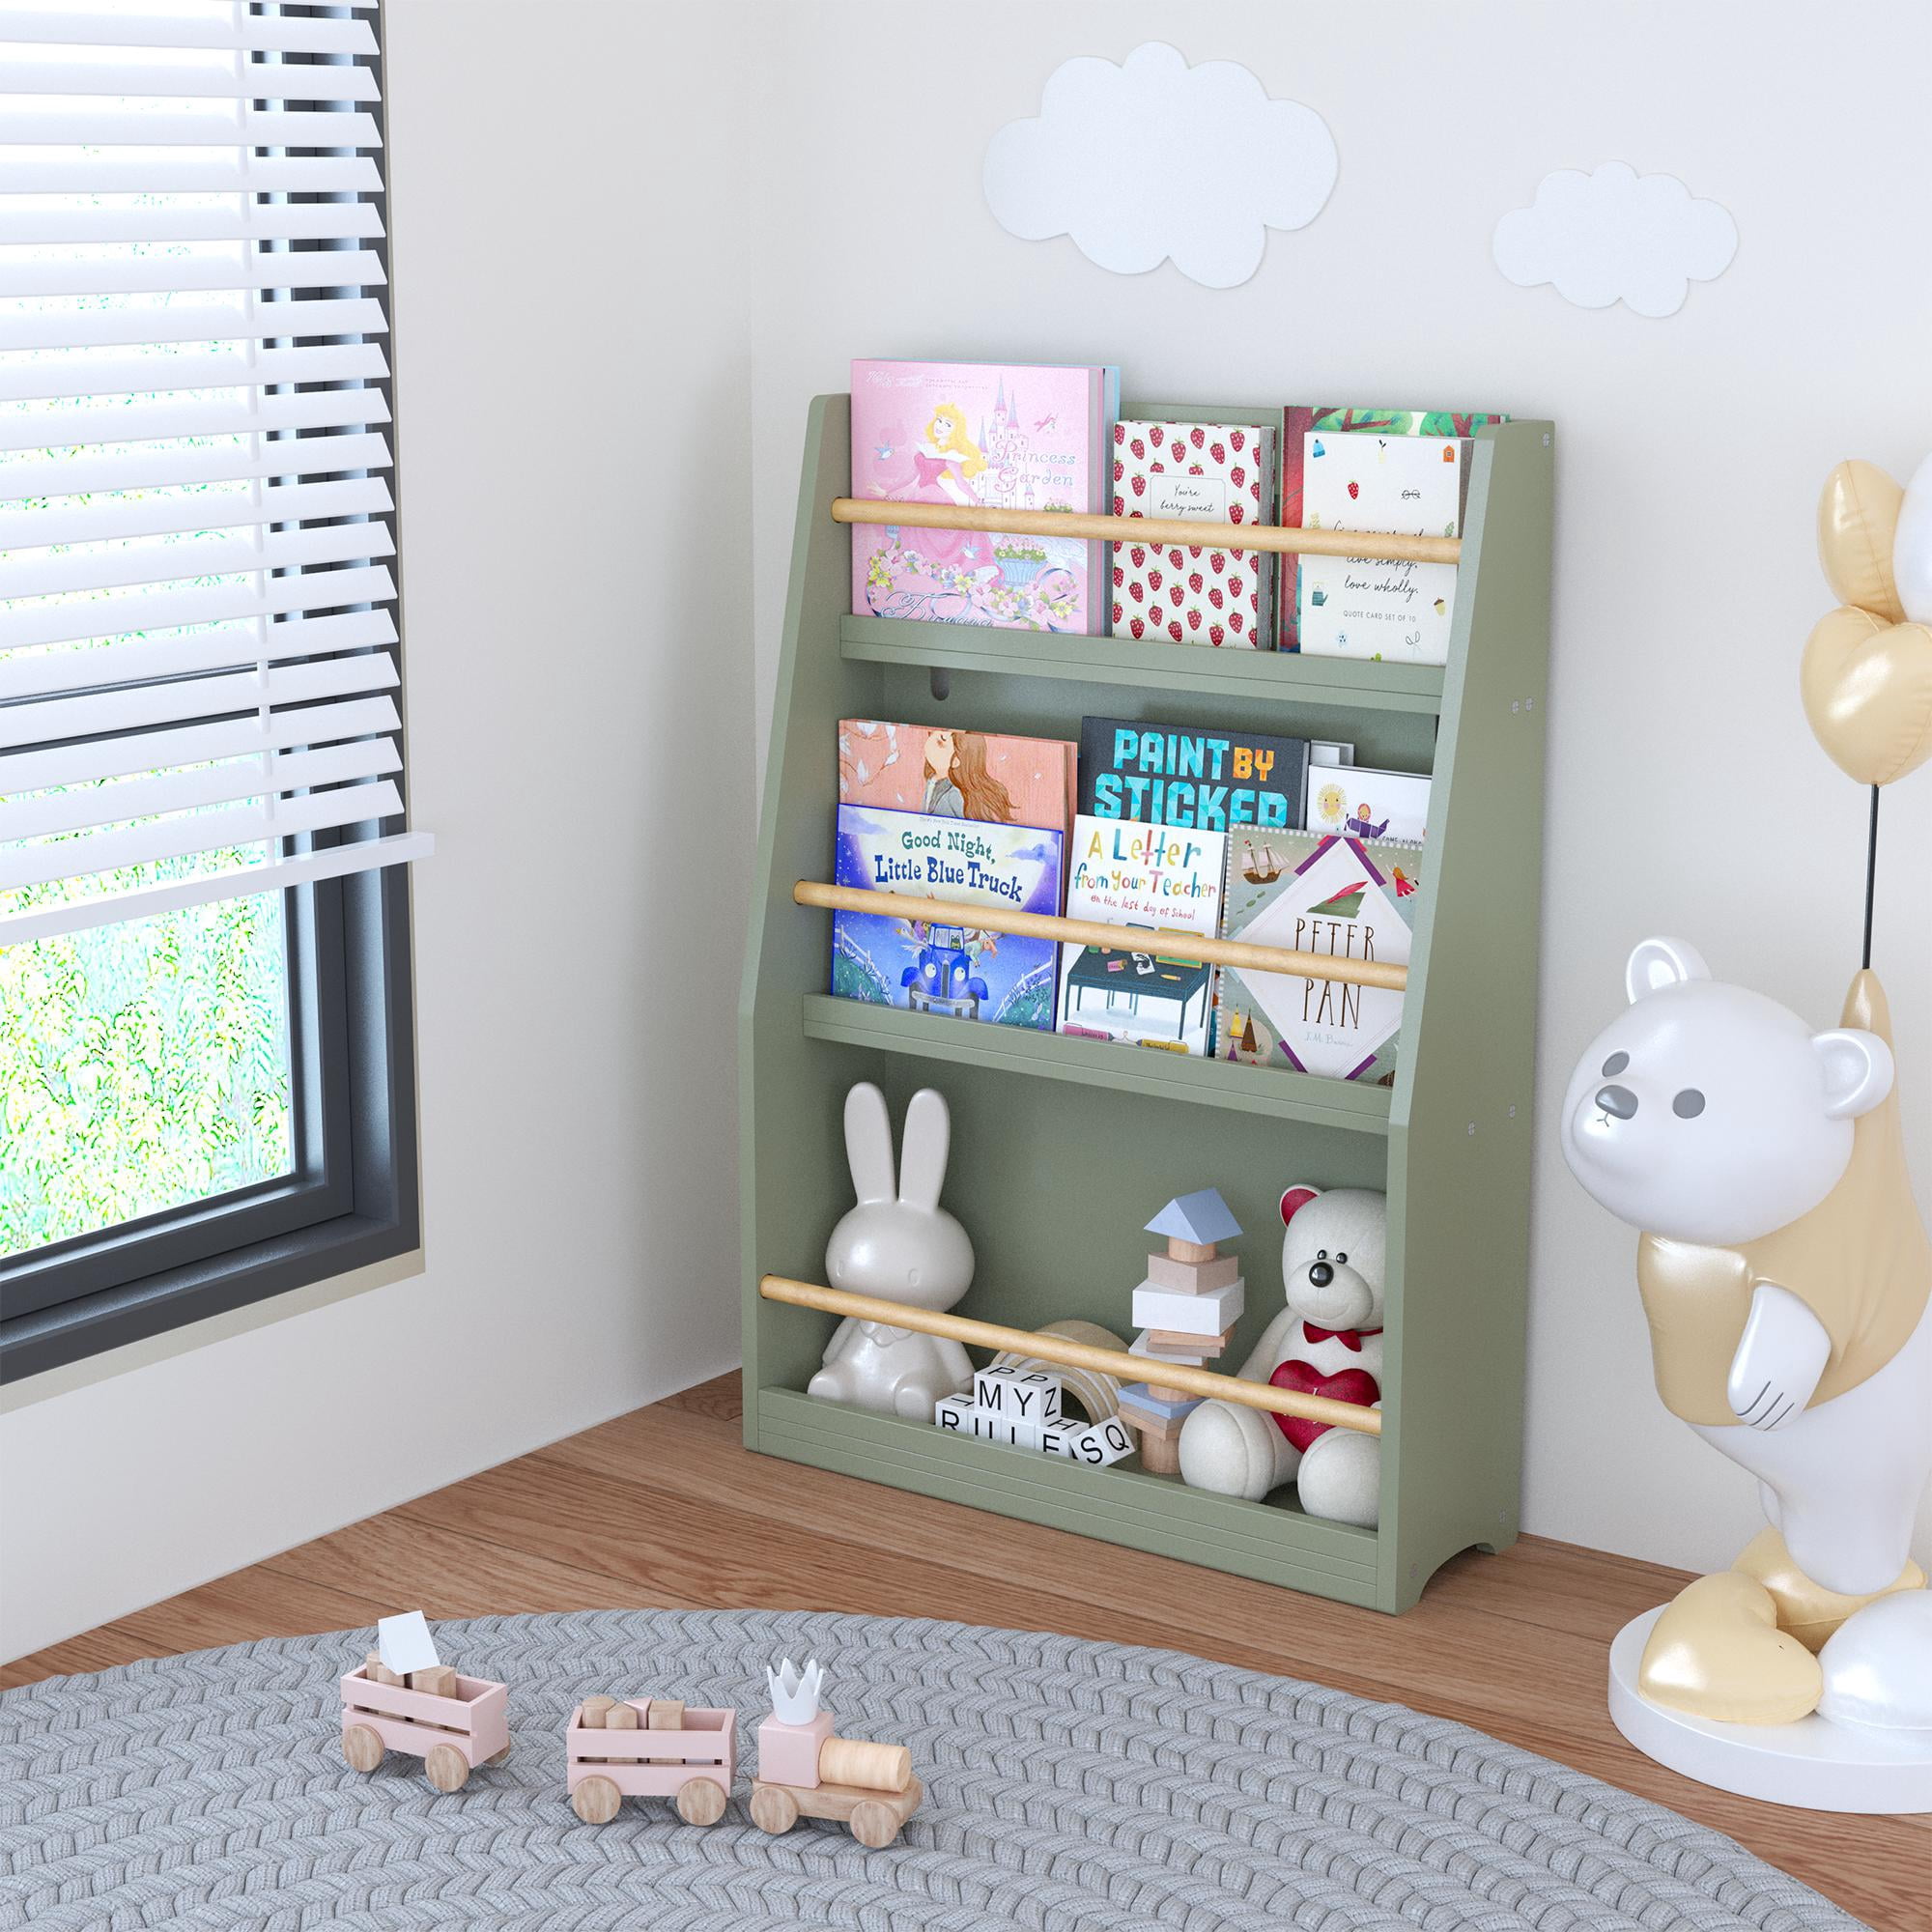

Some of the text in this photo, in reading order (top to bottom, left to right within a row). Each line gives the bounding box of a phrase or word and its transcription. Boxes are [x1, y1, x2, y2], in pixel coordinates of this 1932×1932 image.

[992, 440, 1076, 465] Princess
[994, 467, 1073, 493] Garden
[1175, 483, 1200, 497] You're
[1160, 499, 1214, 516] berry sweet
[1345, 575, 1419, 603] love wholly.
[1343, 610, 1364, 618] QUOTE
[1366, 611, 1382, 620] CARD
[1113, 728, 1275, 781] PAINT BY
[1094, 773, 1288, 833] STICKER
[902, 830, 996, 866] Good Night,
[1088, 828, 1202, 868] A Letter
[874, 855, 1023, 903] Little Blue Truck
[1074, 862, 1217, 898] from your Teacher
[1091, 895, 1100, 903] on
[1104, 895, 1118, 907] the
[1122, 896, 1139, 911] last
[1144, 901, 1157, 917] day
[1160, 907, 1170, 916] of
[1295, 918, 1375, 962] PETER
[1302, 978, 1361, 1029] PAN
